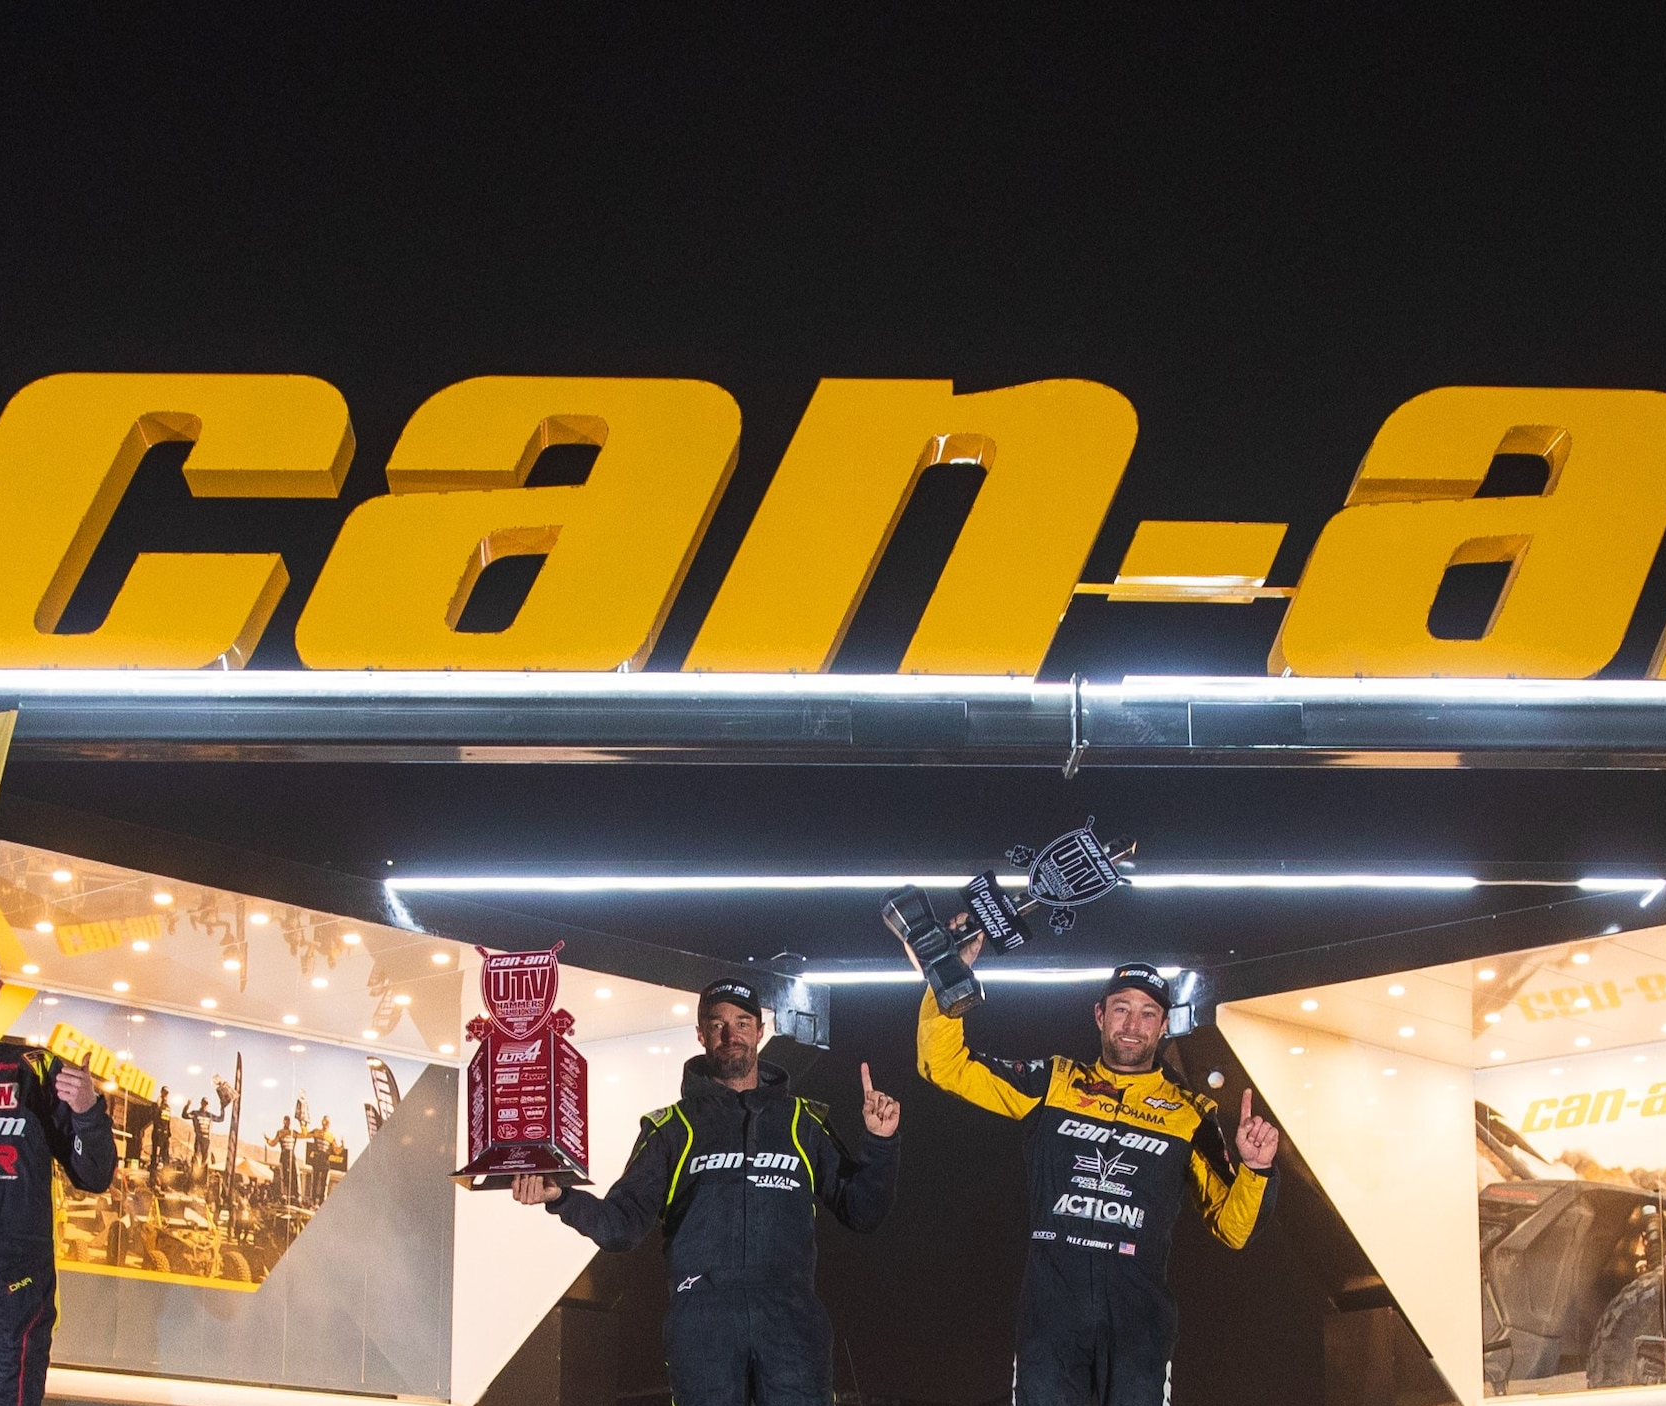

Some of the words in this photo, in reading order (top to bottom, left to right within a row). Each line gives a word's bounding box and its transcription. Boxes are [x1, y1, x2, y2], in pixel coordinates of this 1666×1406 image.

[1051, 840, 1107, 896] UTV
[1080, 834, 1117, 881] can-am
[970, 897, 1002, 939] WINNER
[979, 890, 1012, 935] OVERALL
[490, 953, 550, 968] can-am
[491, 968, 551, 1002] UTV
[496, 1001, 544, 1010] HAMMERS
[47, 1022, 157, 1101] can-am
[1098, 1100, 1166, 1126] YOKOHAMA
[1056, 1118, 1170, 1156] can-am
[689, 1152, 801, 1176] can-am
[1052, 1194, 1140, 1230] ACTION
[7, 1276, 33, 1294] DNA
